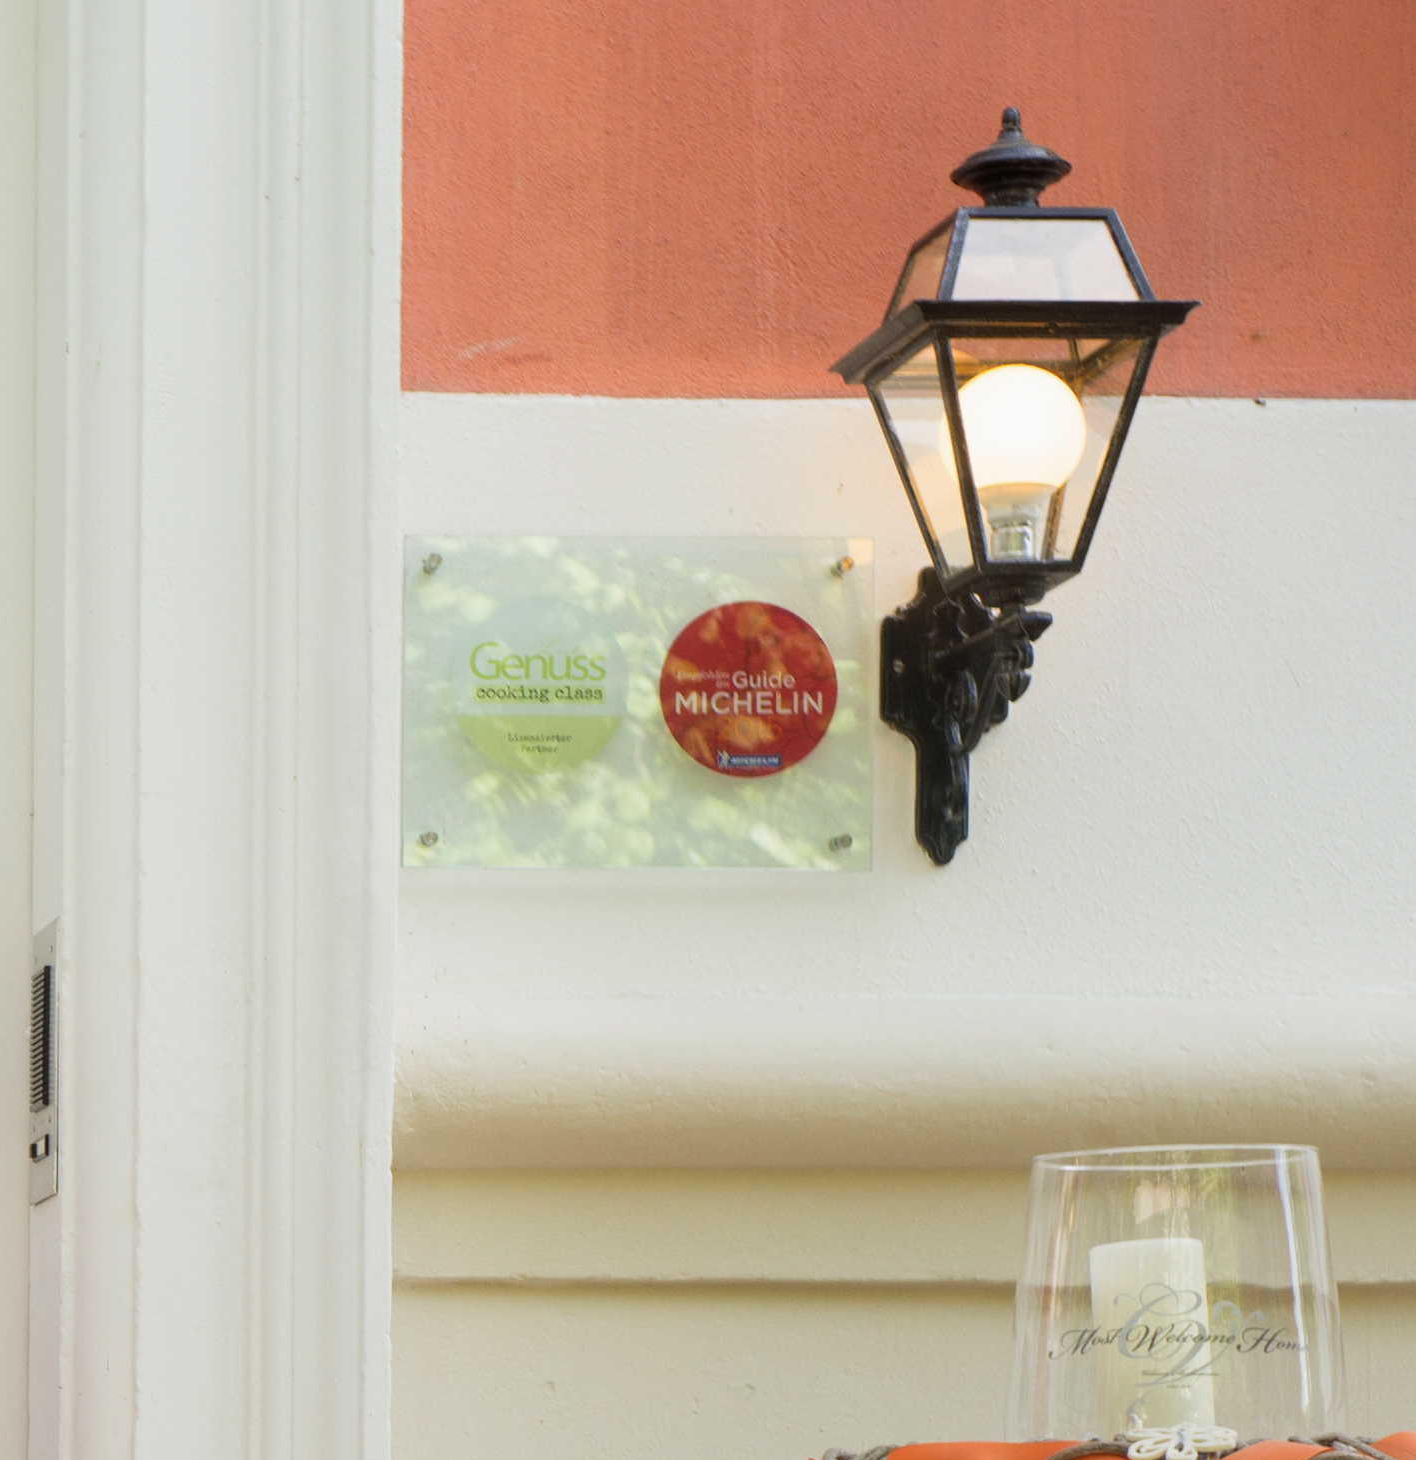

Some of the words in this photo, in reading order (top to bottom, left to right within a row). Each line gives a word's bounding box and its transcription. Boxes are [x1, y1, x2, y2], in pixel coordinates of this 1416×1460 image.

[469, 642, 606, 681] Genuss
[732, 671, 795, 689] Guide
[476, 685, 550, 702] cooking
[555, 686, 603, 700] class
[675, 691, 823, 715] MICHELIN
[521, 745, 558, 753] Partner
[1049, 1326, 1123, 1360] Most
[1125, 1323, 1236, 1352] Welcome
